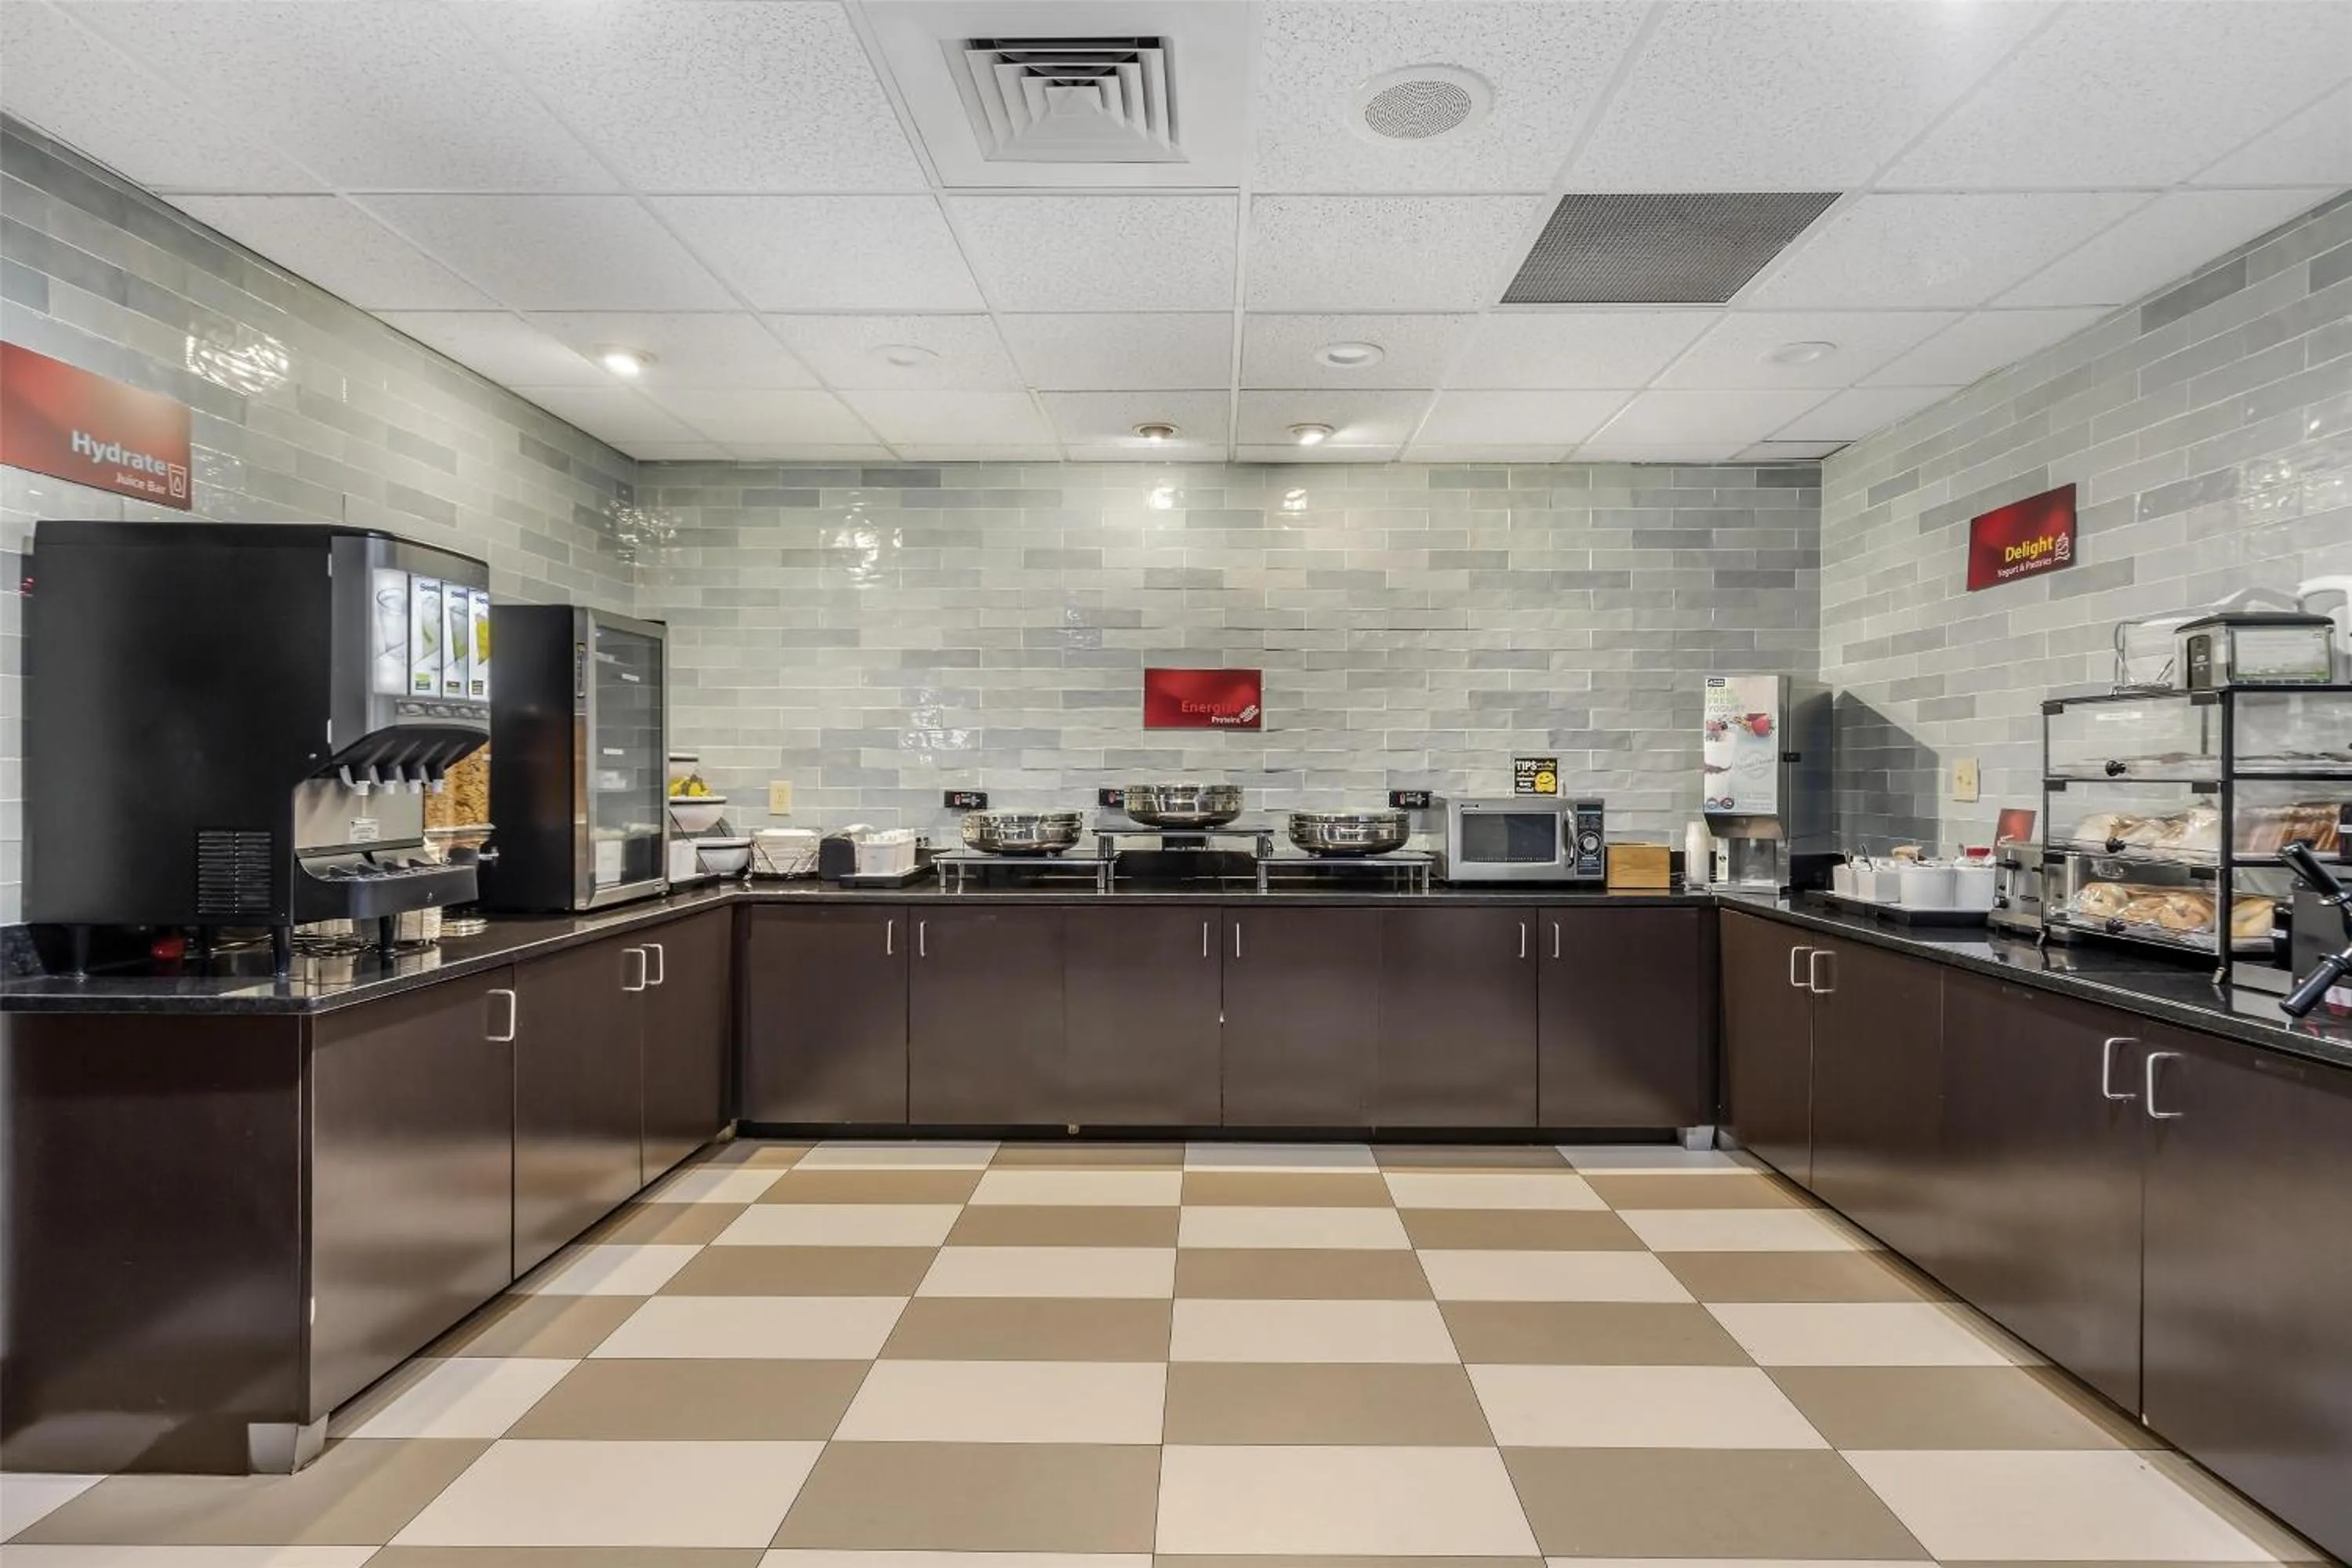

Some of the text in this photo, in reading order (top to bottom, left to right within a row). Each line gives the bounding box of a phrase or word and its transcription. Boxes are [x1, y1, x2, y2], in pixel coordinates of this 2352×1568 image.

[71, 430, 167, 476] Hydrate
[115, 471, 166, 495] Juice Bar
[2005, 535, 2053, 562] Delight
[1997, 565, 2019, 578] Yogurt
[2025, 557, 2053, 570] Pastries
[1515, 760, 1537, 771] TIPS
